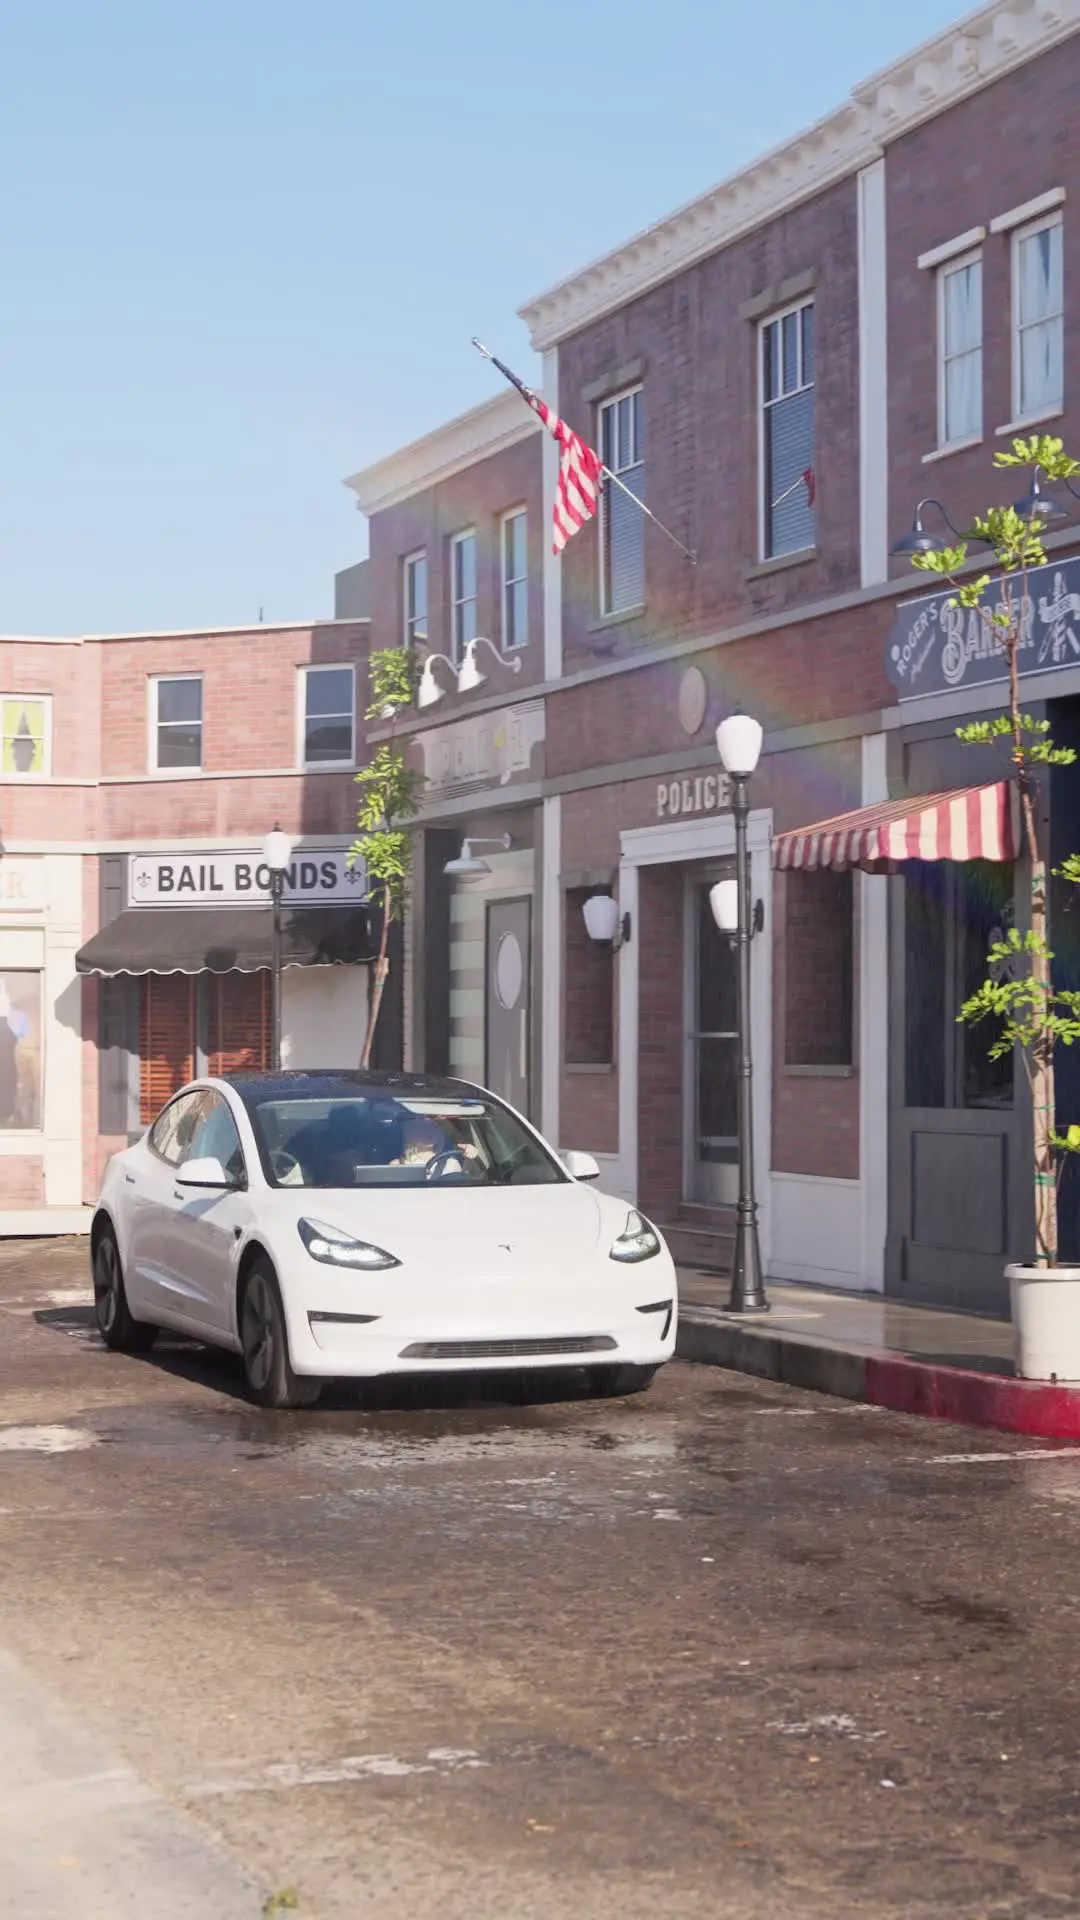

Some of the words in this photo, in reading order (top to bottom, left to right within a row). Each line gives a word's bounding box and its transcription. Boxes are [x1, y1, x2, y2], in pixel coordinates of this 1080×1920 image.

[897, 602, 938, 677] ROGER'S
[657, 773, 731, 817] POLICE
[158, 864, 224, 892] BAIL
[234, 861, 338, 891] BONDS
